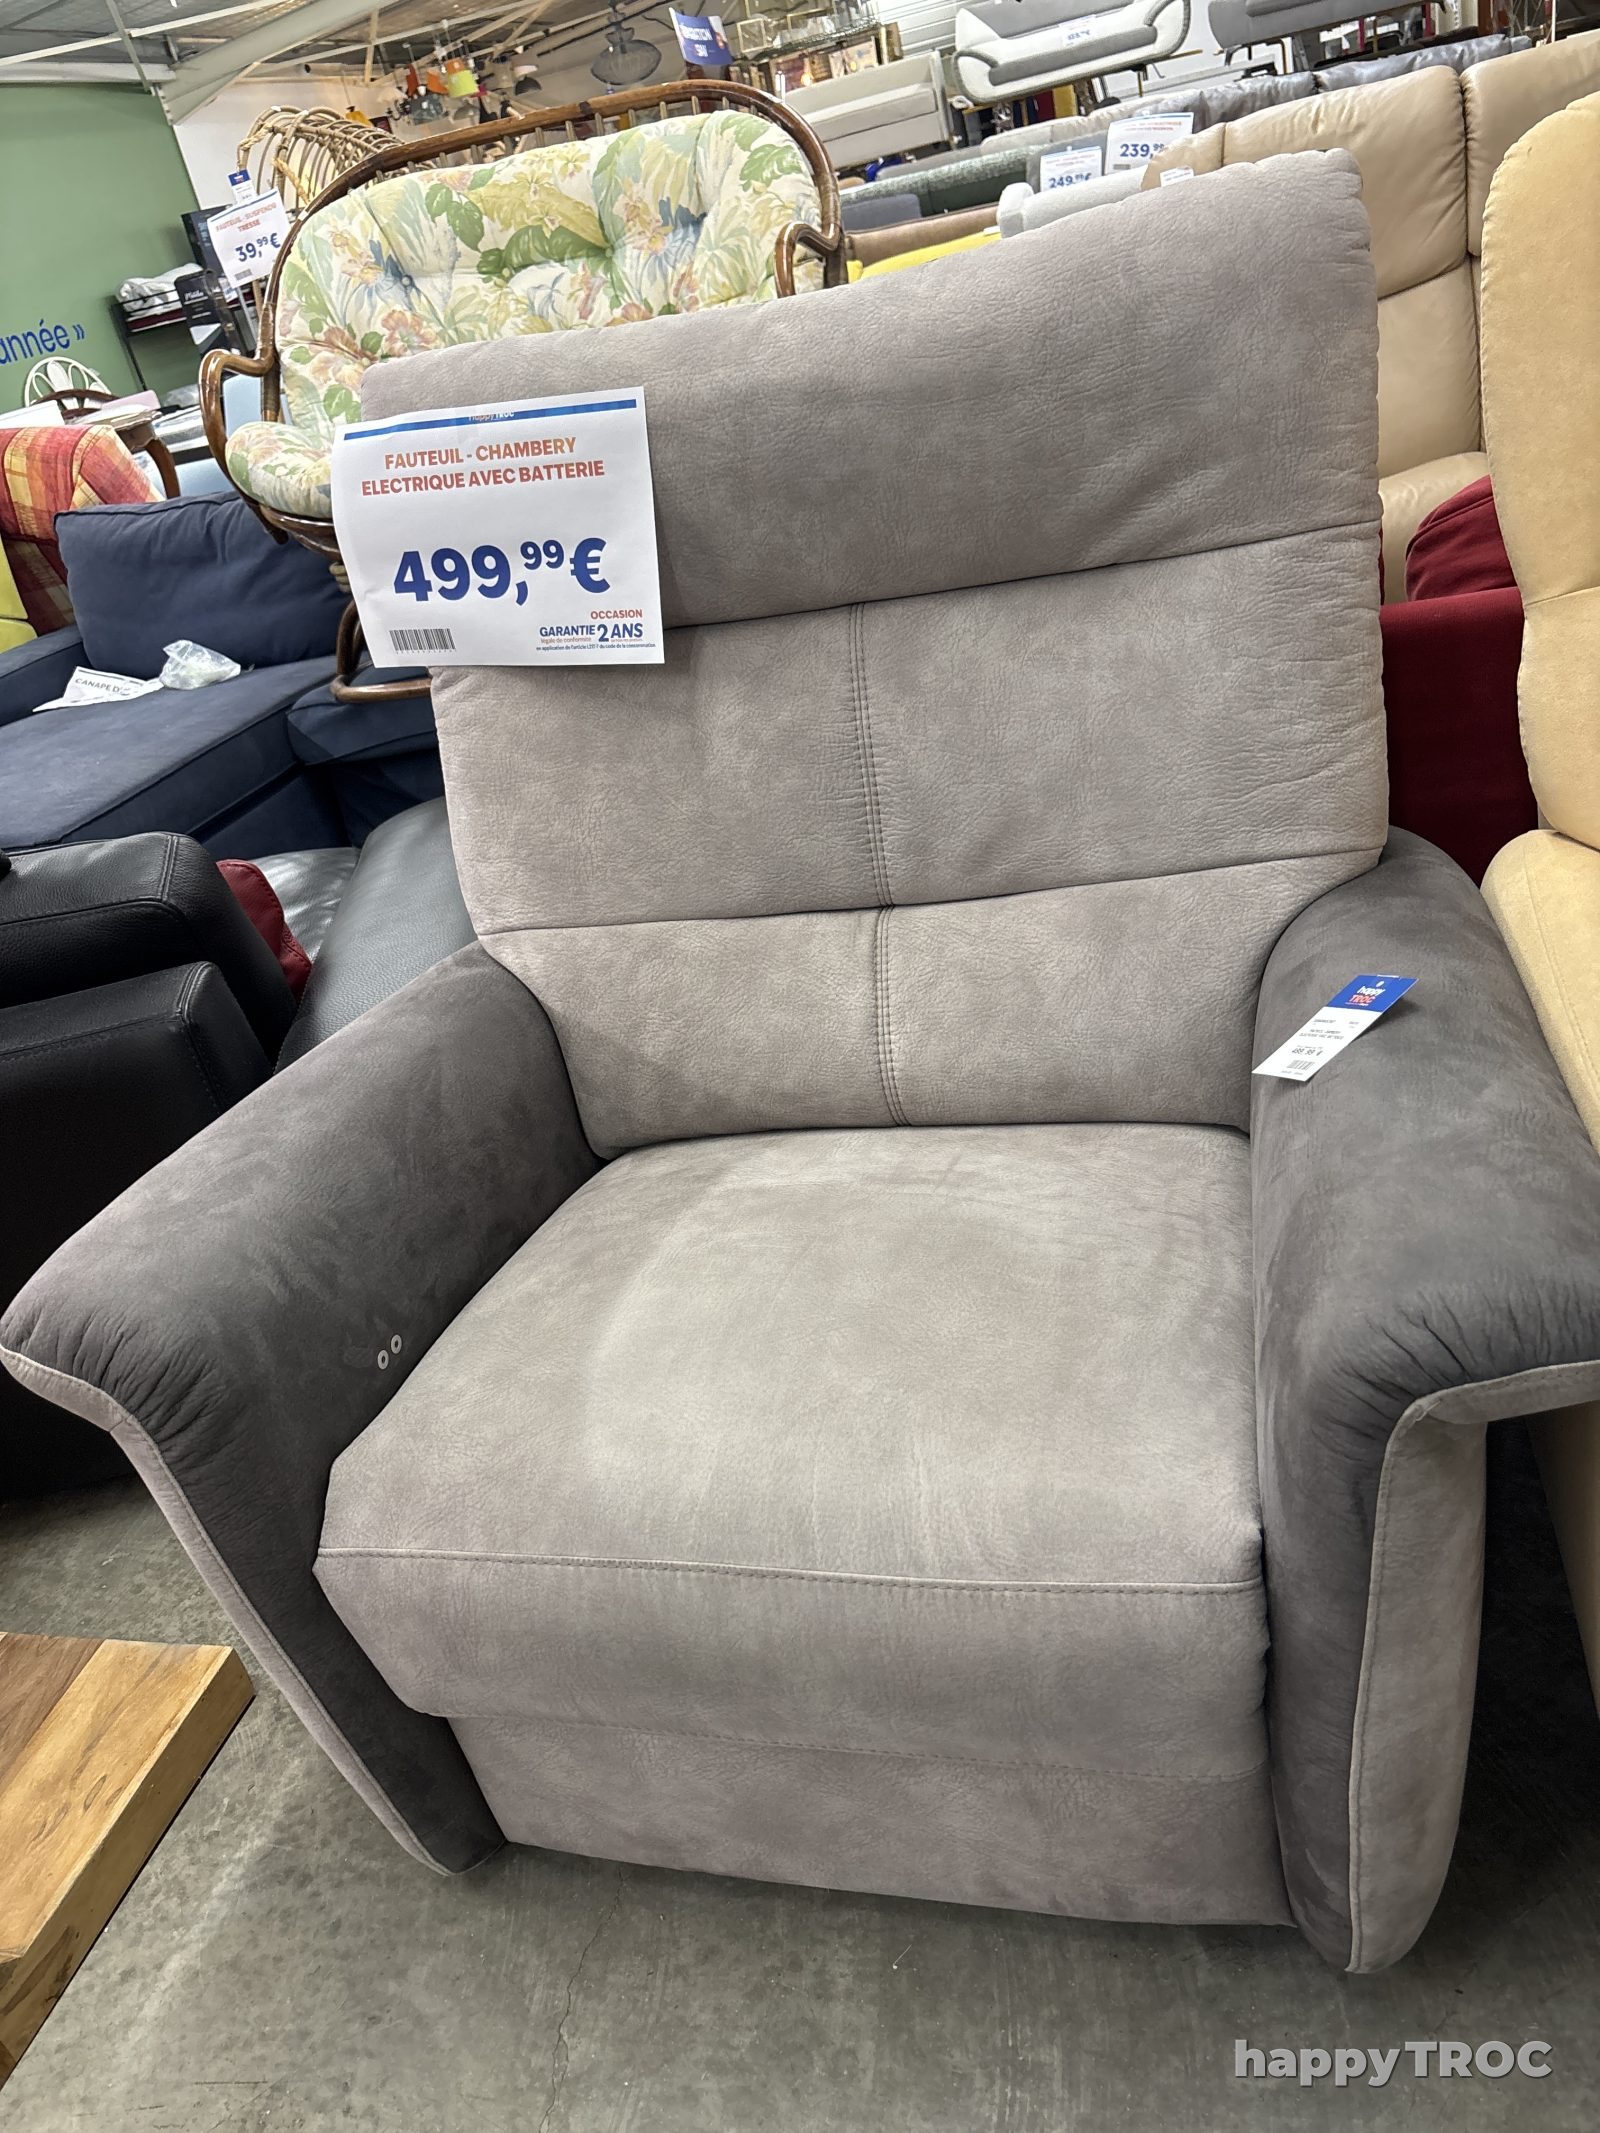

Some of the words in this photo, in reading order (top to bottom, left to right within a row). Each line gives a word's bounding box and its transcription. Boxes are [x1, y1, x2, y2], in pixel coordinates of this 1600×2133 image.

[385, 448, 464, 470] FAUTEUIL
[475, 437, 577, 462] CHAMBERY
[361, 473, 465, 496] ELECTRIQUE
[468, 468, 516, 487] AVEC
[519, 460, 605, 482] BATTERIE
[590, 609, 643, 620] OCCASION
[539, 624, 596, 637] GARANTIE
[597, 623, 609, 643] 2
[610, 622, 643, 639] ANS
